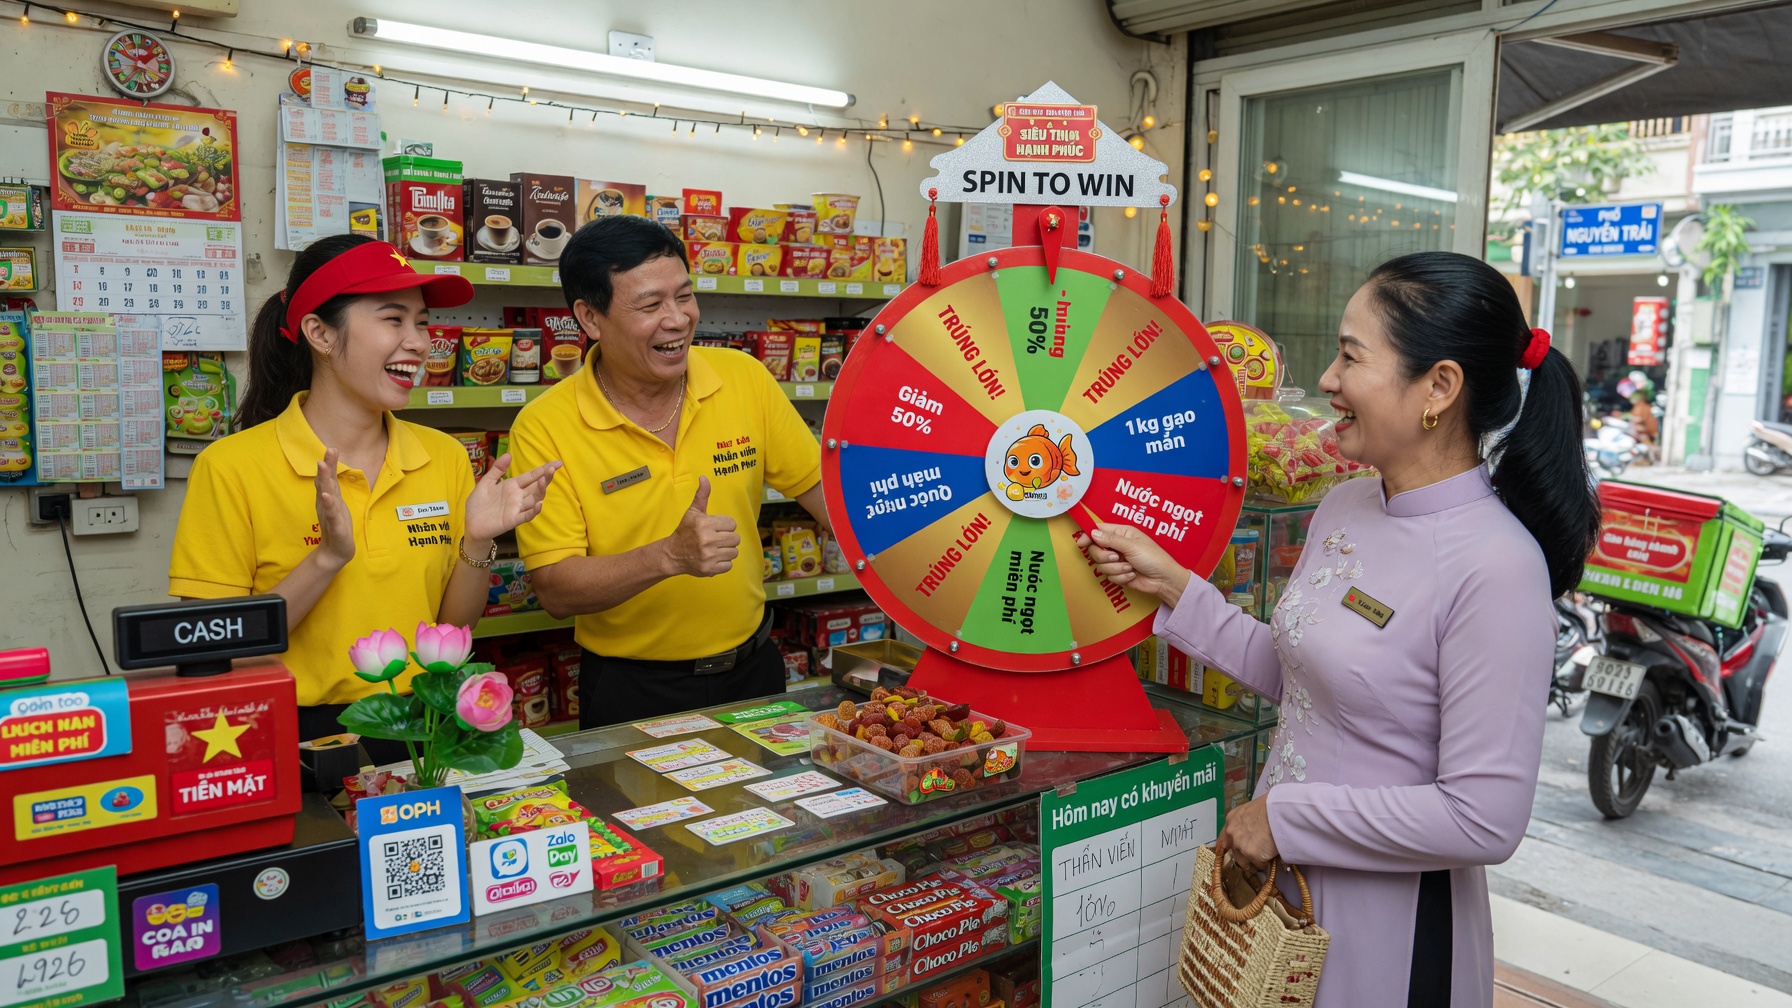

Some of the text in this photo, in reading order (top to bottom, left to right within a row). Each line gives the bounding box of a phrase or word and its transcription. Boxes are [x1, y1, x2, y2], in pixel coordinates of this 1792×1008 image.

[1052, 142, 1084, 156] PHÚC
[963, 170, 1134, 197] SPIN TO WIN
[938, 304, 980, 362] TRÚNG
[1026, 306, 1049, 354] 50%
[1082, 319, 1164, 404] TRÚNG LỚN!
[890, 406, 932, 435] 50%
[1162, 410, 1196, 430] gạo
[1114, 477, 1204, 526] Nước ngọt
[409, 534, 438, 547] Hạnh
[1154, 521, 1189, 542] phí
[915, 547, 963, 598] TRÚNG
[1001, 595, 1017, 625] phí
[1020, 596, 1037, 635] ngọt
[174, 617, 243, 644] CASH
[58, 732, 90, 751] PHÍ
[226, 773, 267, 797] MẶT
[1052, 803, 1087, 830] Hôm
[1091, 796, 1118, 818] nay
[1121, 785, 1139, 809] có
[1193, 761, 1216, 788] mãi
[399, 800, 441, 820] OPH
[546, 831, 576, 847] Zalo
[904, 908, 953, 927] Choco
[141, 919, 213, 945] COA IN
[913, 927, 957, 951] Choco
[700, 949, 783, 984] mentos
[914, 950, 957, 975] Choco
[705, 963, 797, 1008] mentos
